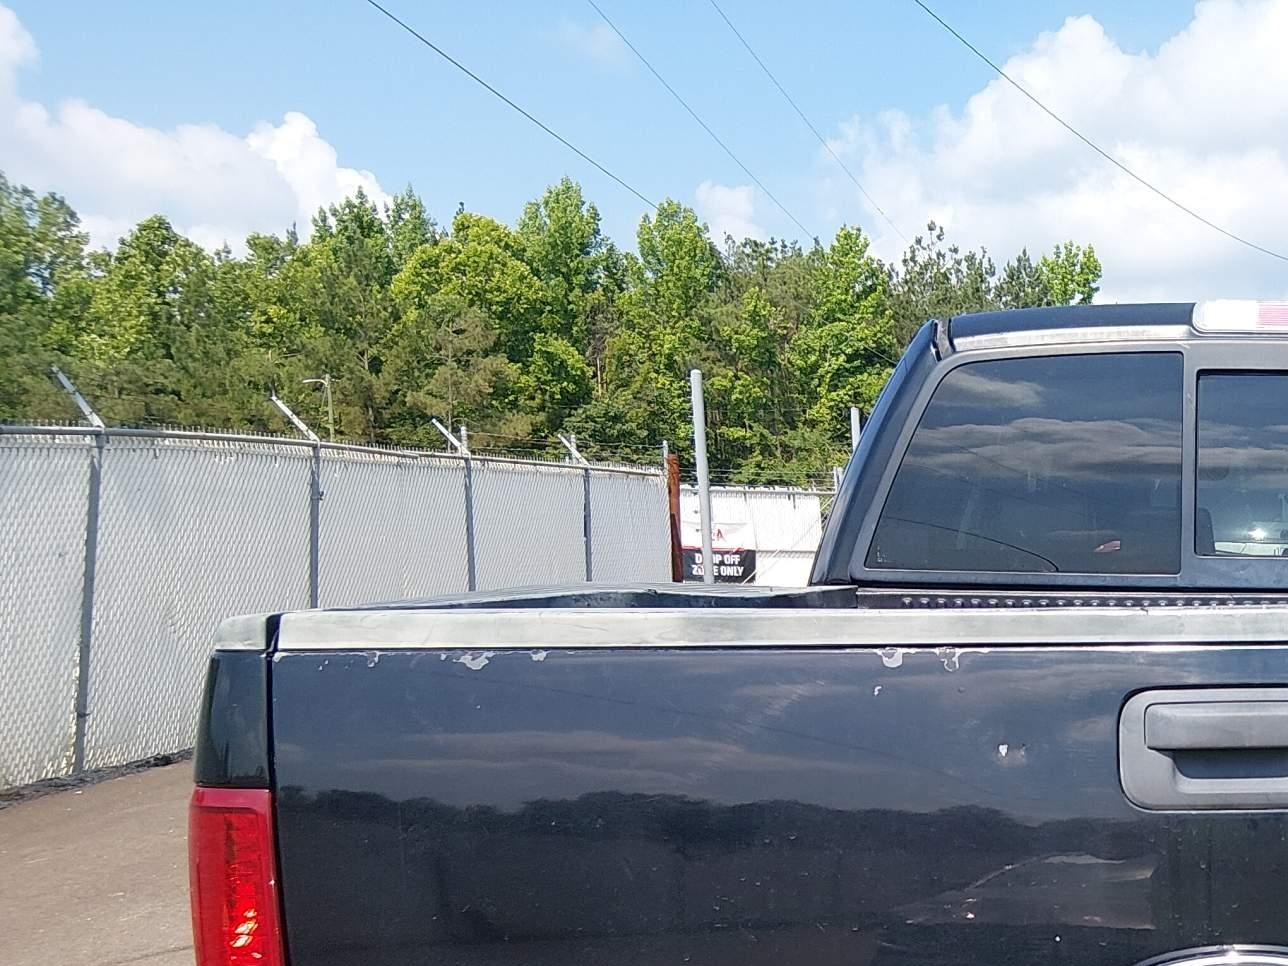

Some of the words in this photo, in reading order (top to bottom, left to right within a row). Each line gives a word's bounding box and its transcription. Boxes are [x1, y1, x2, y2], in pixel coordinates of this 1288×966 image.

[723, 554, 741, 565] OFF
[690, 564, 719, 576] ZOE
[719, 565, 744, 577] ONLY
